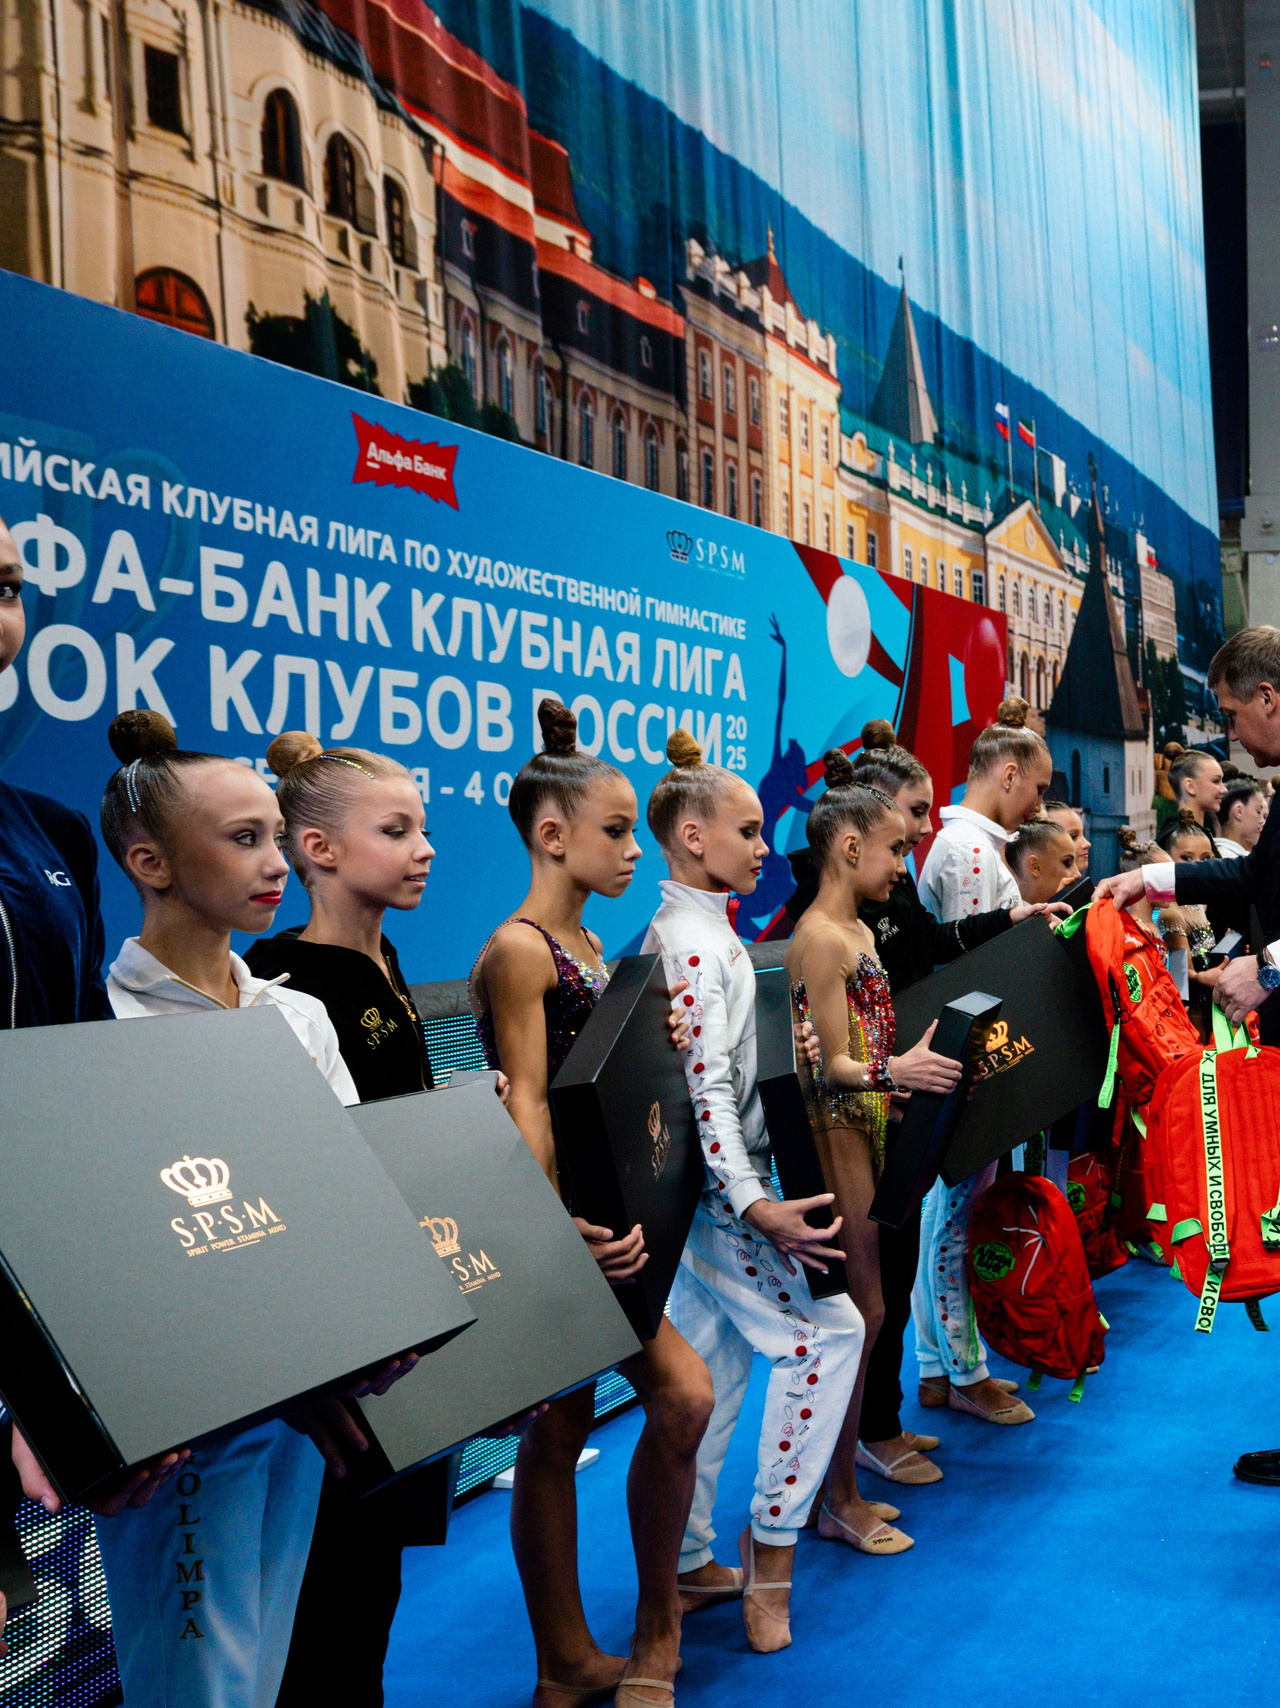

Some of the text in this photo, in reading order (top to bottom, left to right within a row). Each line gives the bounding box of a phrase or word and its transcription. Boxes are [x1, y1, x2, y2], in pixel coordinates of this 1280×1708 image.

[367, 441, 447, 481] Альфа Банк
[162, 480, 320, 547] КЛУБНАЯ
[327, 521, 397, 563] ЛИГА
[404, 537, 440, 573] ПО
[447, 548, 642, 619] ХУДОЖЕСТВЕННОЙ
[645, 597, 746, 641] ГИМНАСТИКЕ
[411, 587, 640, 685] КЛУБНАЯ
[652, 637, 747, 701] ЛИГА
[0, 623, 177, 729] ОК
[209, 644, 515, 753] КЛУБОВ
[725, 714, 747, 741] 20
[725, 744, 747, 771] 25
[464, 770, 485, 805] 4
[1201, 1072, 1217, 1106] ДЛЯ
[1204, 1109, 1222, 1172] УМНЫХ
[1208, 1175, 1222, 1187] И
[186, 1223, 287, 1258] SPIRIT POWER STAMINA MIND
[175, 1472, 206, 1640] OLIMPA
